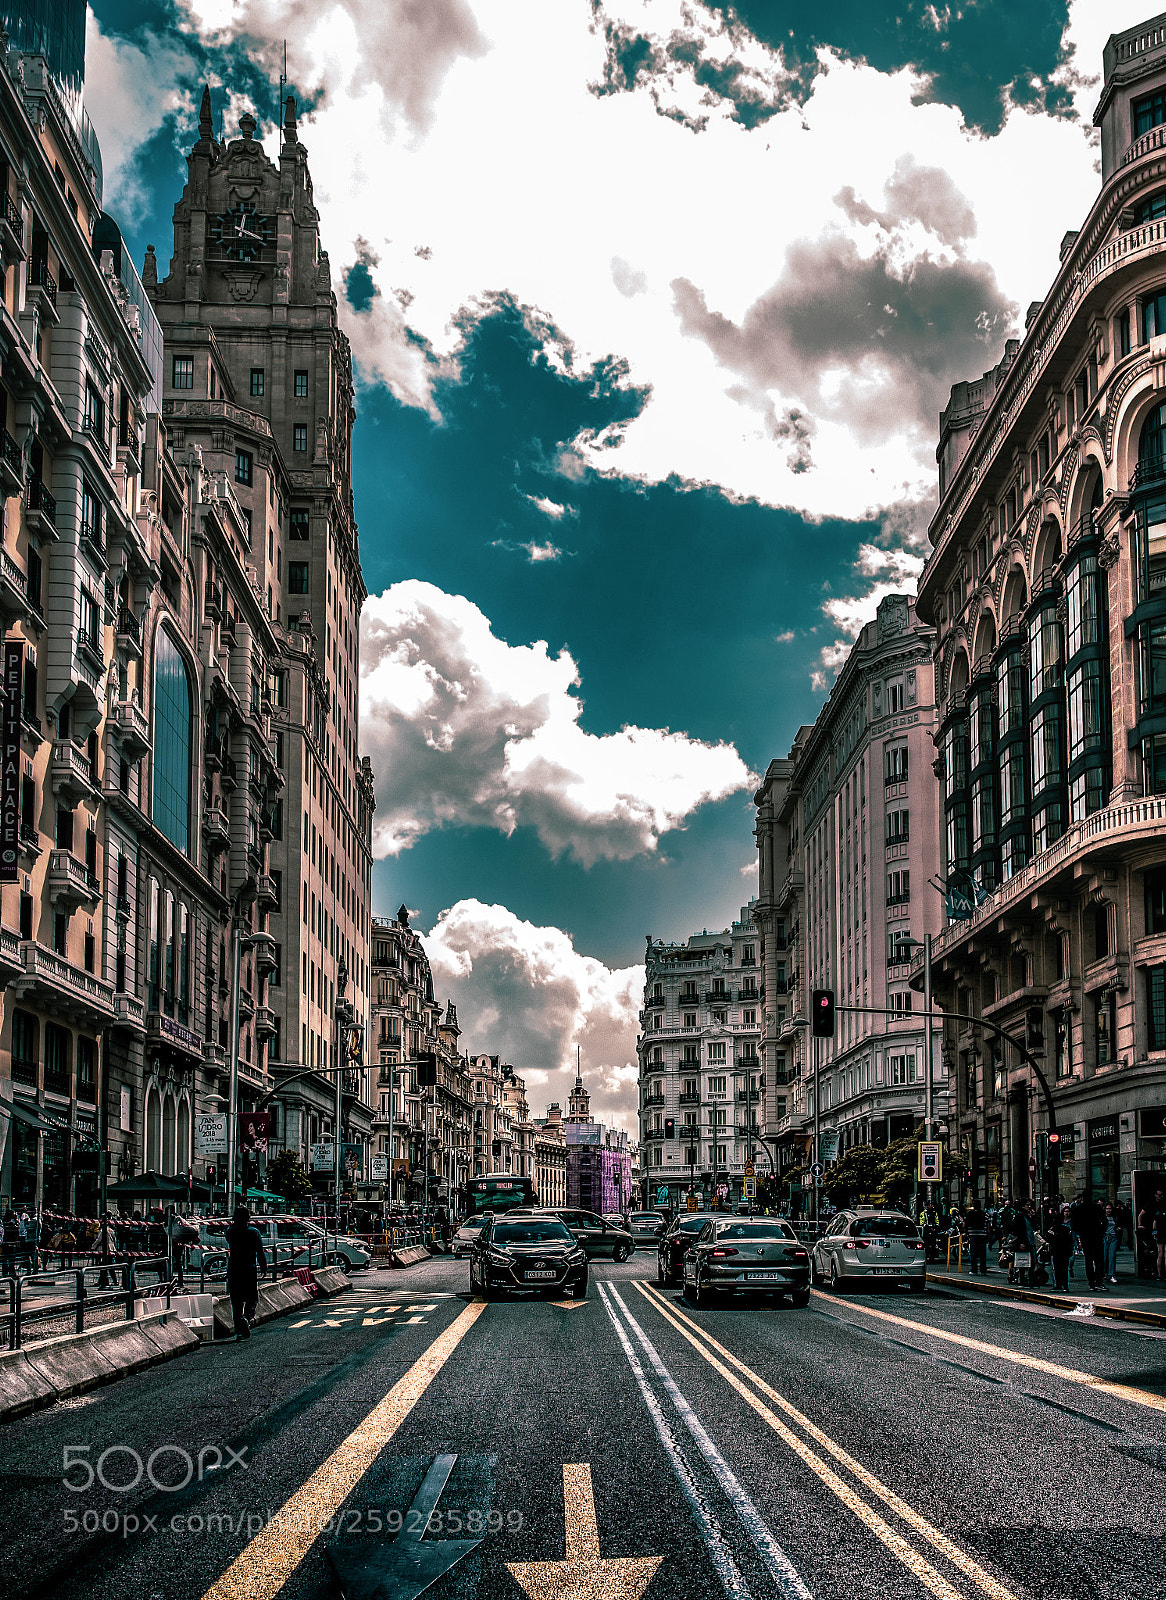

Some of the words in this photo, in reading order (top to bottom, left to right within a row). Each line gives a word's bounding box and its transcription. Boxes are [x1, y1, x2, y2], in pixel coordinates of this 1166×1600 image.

[7, 654, 19, 734] PETIT
[4, 743, 17, 842] PALACE
[199, 1117, 214, 1126] SAN
[287, 1316, 429, 1329] TAXI
